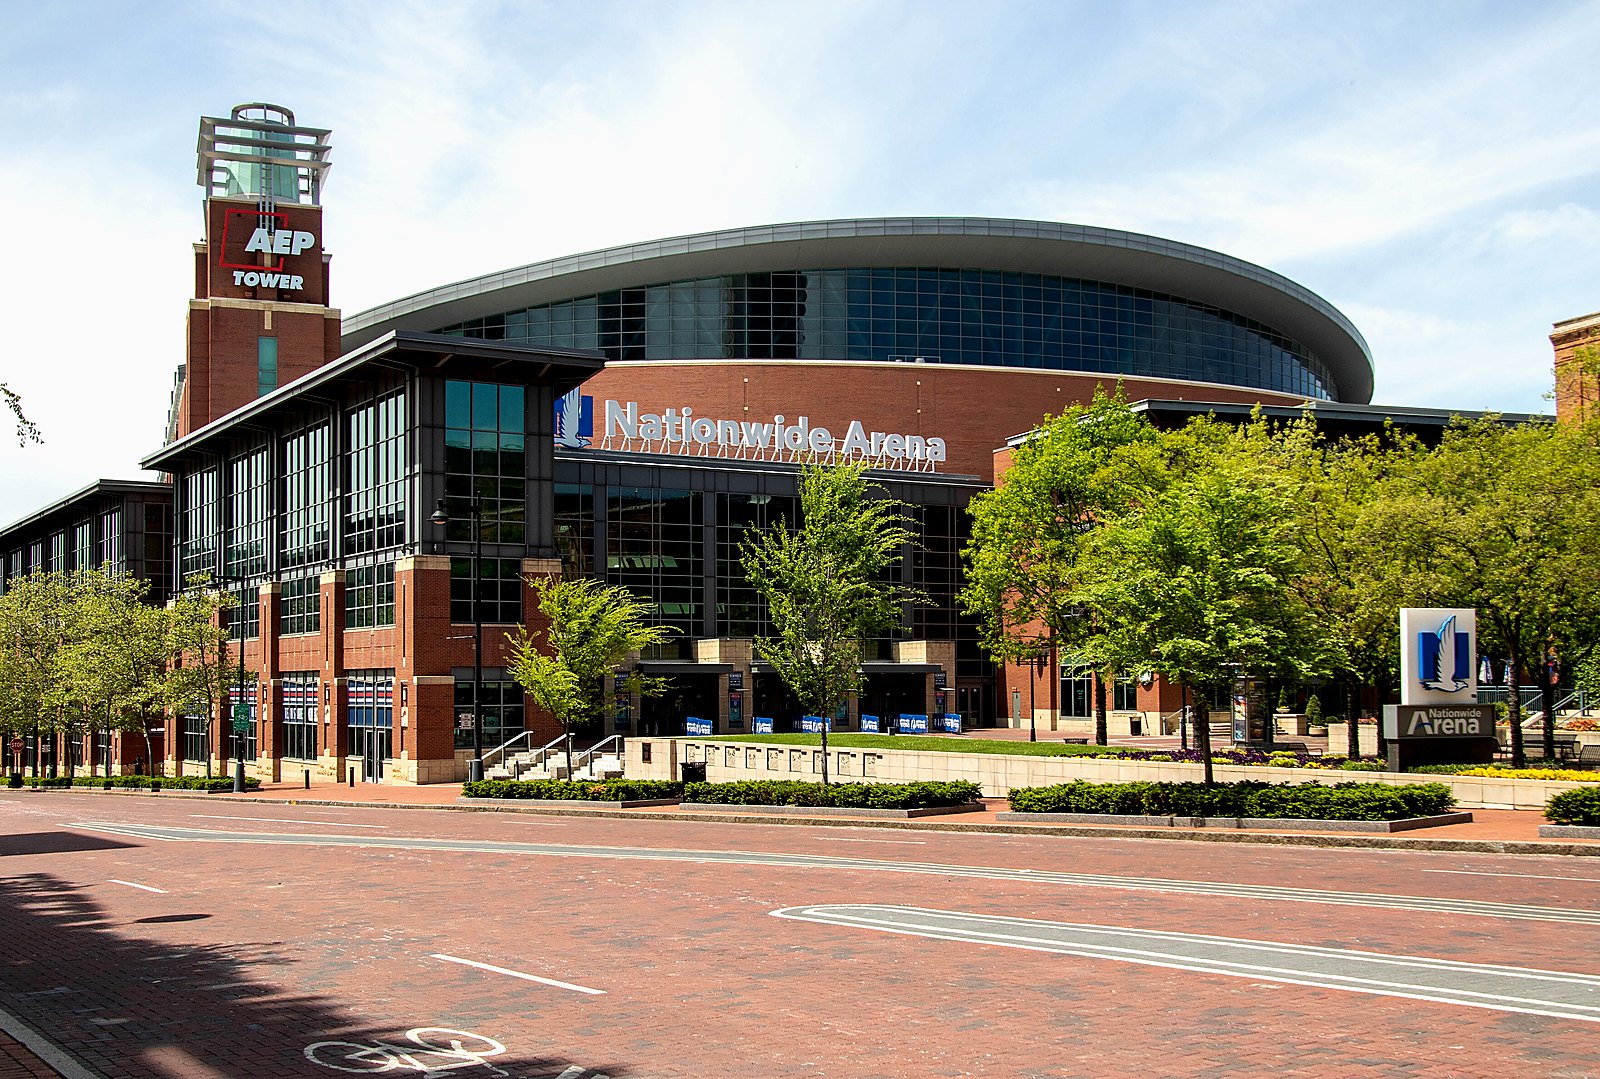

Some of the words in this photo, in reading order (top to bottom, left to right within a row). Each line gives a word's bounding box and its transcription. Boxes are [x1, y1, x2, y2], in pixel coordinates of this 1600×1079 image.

[245, 227, 315, 255] AEP
[232, 271, 304, 290] TOWER
[606, 400, 832, 453] Nationwide
[845, 420, 946, 462] Arena
[1407, 711, 1480, 735] Arena
[1429, 708, 1482, 718] Nationwide
